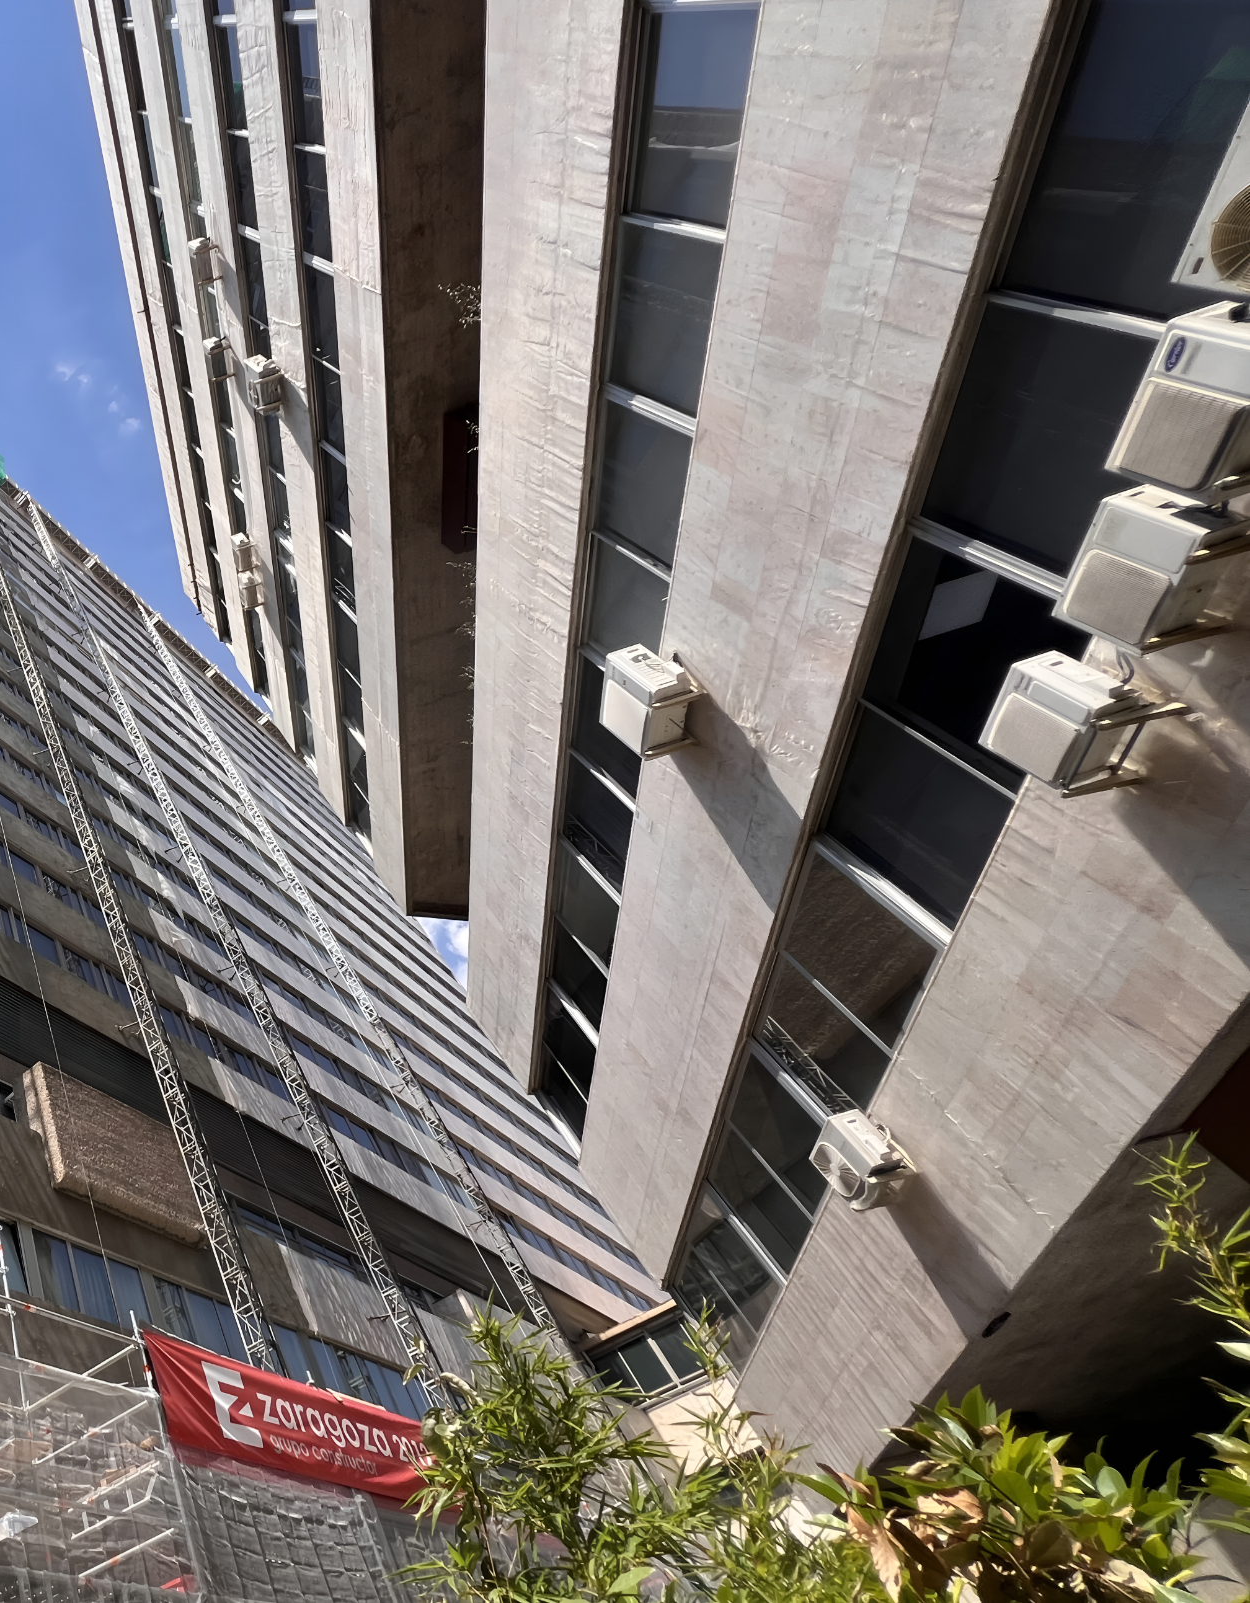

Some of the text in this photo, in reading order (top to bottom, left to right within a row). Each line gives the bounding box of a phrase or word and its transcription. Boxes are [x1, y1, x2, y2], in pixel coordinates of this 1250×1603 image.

[256, 1392, 393, 1458] zaragoza
[269, 1434, 379, 1476] grupo constructor
